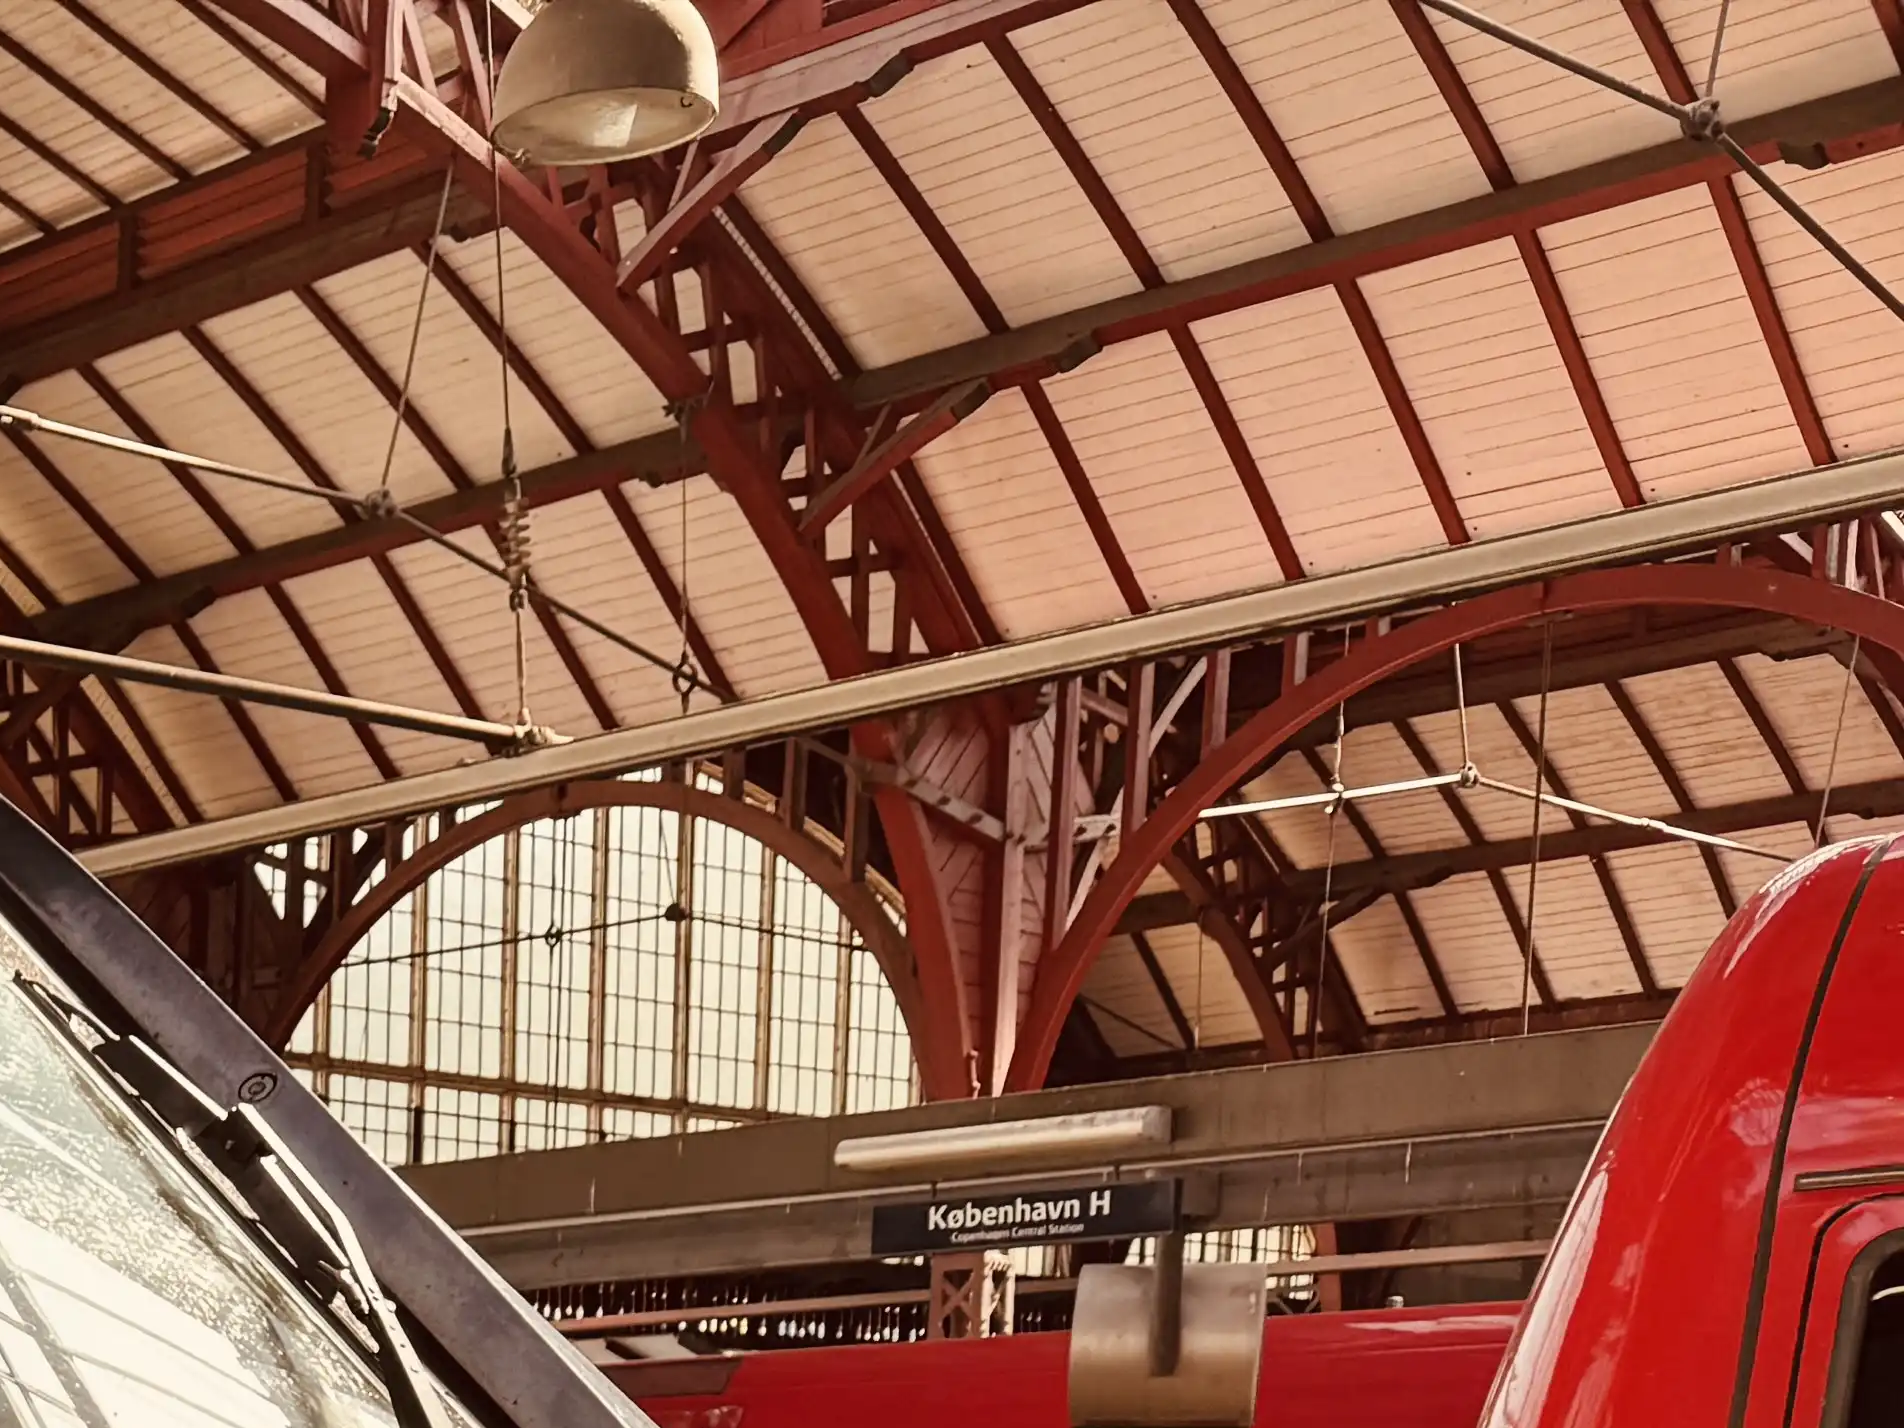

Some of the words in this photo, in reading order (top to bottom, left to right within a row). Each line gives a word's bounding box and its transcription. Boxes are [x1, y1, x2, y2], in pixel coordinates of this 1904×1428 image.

[928, 1197, 1081, 1231] København
[1089, 1189, 1111, 1217] H
[1048, 1223, 1085, 1235] Station
